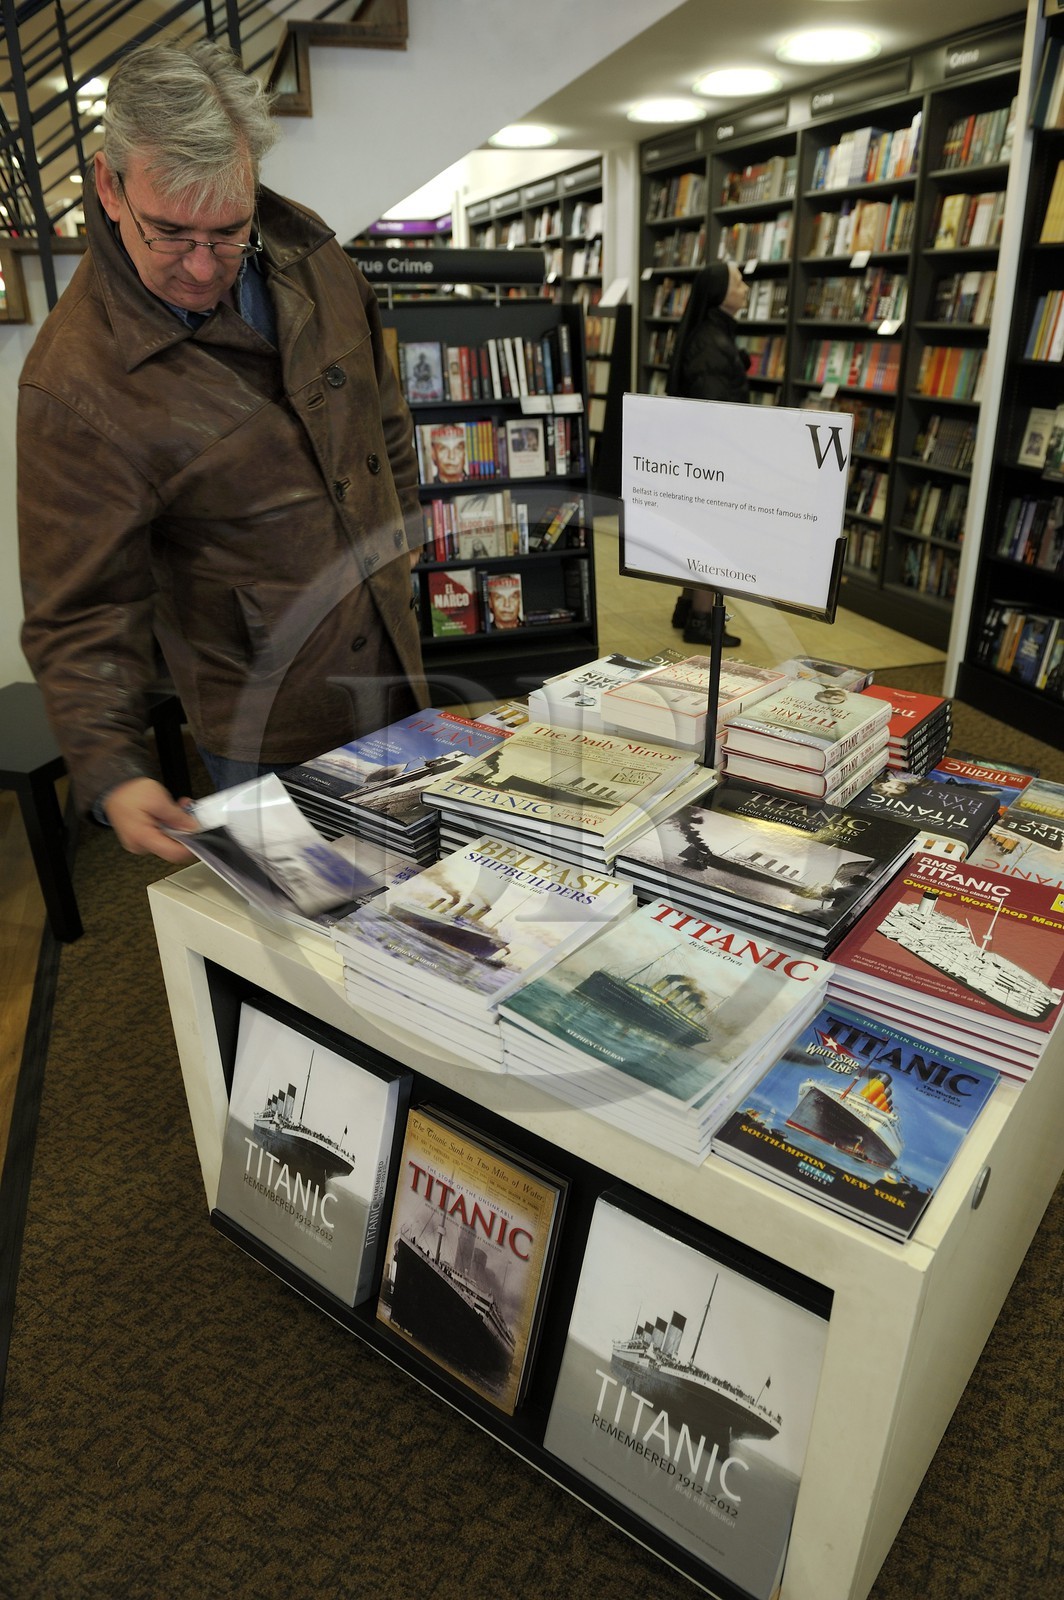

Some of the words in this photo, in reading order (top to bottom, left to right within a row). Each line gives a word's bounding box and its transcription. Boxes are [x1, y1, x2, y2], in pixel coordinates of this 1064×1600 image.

[949, 49, 979, 68] Crime
[352, 257, 383, 274] True
[387, 257, 434, 274] Crime
[805, 423, 848, 473] W
[633, 455, 680, 477] Titanic
[684, 462, 725, 483] Town
[632, 496, 643, 506] this
[644, 499, 659, 509] year.
[632, 486, 652, 497] Belfast
[653, 489, 658, 498] is
[659, 491, 693, 504] celebrating
[694, 495, 705, 504] the
[706, 498, 739, 511] centenary
[739, 501, 748, 511] of
[748, 503, 756, 512] its
[757, 506, 775, 515] most
[776, 507, 802, 519] famous
[803, 512, 818, 523] ship
[687, 557, 757, 584] Waterstones
[434, 594, 469, 609] NARCO
[445, 583, 454, 594] EL
[440, 712, 483, 728] CENTENARY
[441, 721, 464, 731] FATHER
[769, 705, 838, 729] TITANIC
[434, 737, 456, 747] ALBUM
[532, 726, 566, 740] The
[571, 734, 621, 751] Daily
[622, 743, 682, 762] Mirror
[943, 760, 1008, 784] TITANIC
[1007, 774, 1025, 784] THE
[440, 781, 554, 815] TITANIC
[737, 806, 763, 816] DANIEL
[751, 790, 872, 832] TITANIC
[866, 792, 970, 829] TITANIC
[921, 787, 984, 810] HART
[941, 801, 979, 815] EVA
[554, 812, 602, 827] STORY
[743, 800, 760, 809] IN
[761, 804, 860, 837] PHOTOGRAPHS
[475, 839, 619, 898] BELFAST
[919, 856, 958, 872] RMS
[464, 851, 597, 906] SHIPBUILDERS
[916, 862, 1012, 898] TITANIC
[938, 880, 969, 894] (Olympic
[969, 889, 992, 901] class)
[902, 878, 957, 898] Owners'
[960, 894, 1028, 920] Workshop
[1031, 914, 1064, 930] Man
[386, 943, 414, 960] STEPHEN
[413, 953, 440, 970] CAMERON
[650, 902, 820, 983] TITANIC
[689, 939, 721, 960] Belfast's
[722, 952, 743, 967] Own
[921, 982, 949, 995] passenger
[949, 989, 961, 998] ship
[565, 1027, 597, 1050] STEPHEN
[594, 1042, 627, 1064] CAMERON
[862, 1018, 880, 1032] THE
[881, 1028, 911, 1047] PITKIN
[912, 1041, 942, 1057] GUIDE
[943, 1053, 956, 1063] TO
[804, 1042, 836, 1065] WHITE
[833, 1052, 861, 1071] STAR
[826, 1016, 980, 1098] TITANIC
[826, 1059, 854, 1076] LINE
[915, 1087, 942, 1103] Largest
[942, 1096, 964, 1109] Liner
[922, 1084, 936, 1095] The
[935, 1088, 962, 1103] World's
[412, 1118, 426, 1133] The
[426, 1126, 449, 1149] Titanic
[449, 1141, 465, 1158] Sunk
[466, 1153, 474, 1162] in
[476, 1156, 490, 1172] Two
[491, 1166, 510, 1184] Miles
[511, 1178, 520, 1189] of
[739, 1124, 827, 1171] SOUTHAMPTON
[841, 1174, 871, 1193] NEW
[874, 1188, 907, 1210] YORK
[244, 1136, 338, 1229] TITANIC
[798, 1161, 836, 1185] PITKIN
[243, 1172, 296, 1216] REMEMBERED
[427, 1165, 437, 1175] THE
[438, 1171, 455, 1187] STORY
[456, 1184, 464, 1192] OF
[465, 1187, 477, 1199] THE
[478, 1196, 515, 1221] UNSINKABLE
[408, 1160, 535, 1262] TITANIC
[364, 1202, 381, 1249] TITANIC
[592, 1413, 676, 1477] REMEMBERED
[595, 1368, 750, 1503] TITANIC
